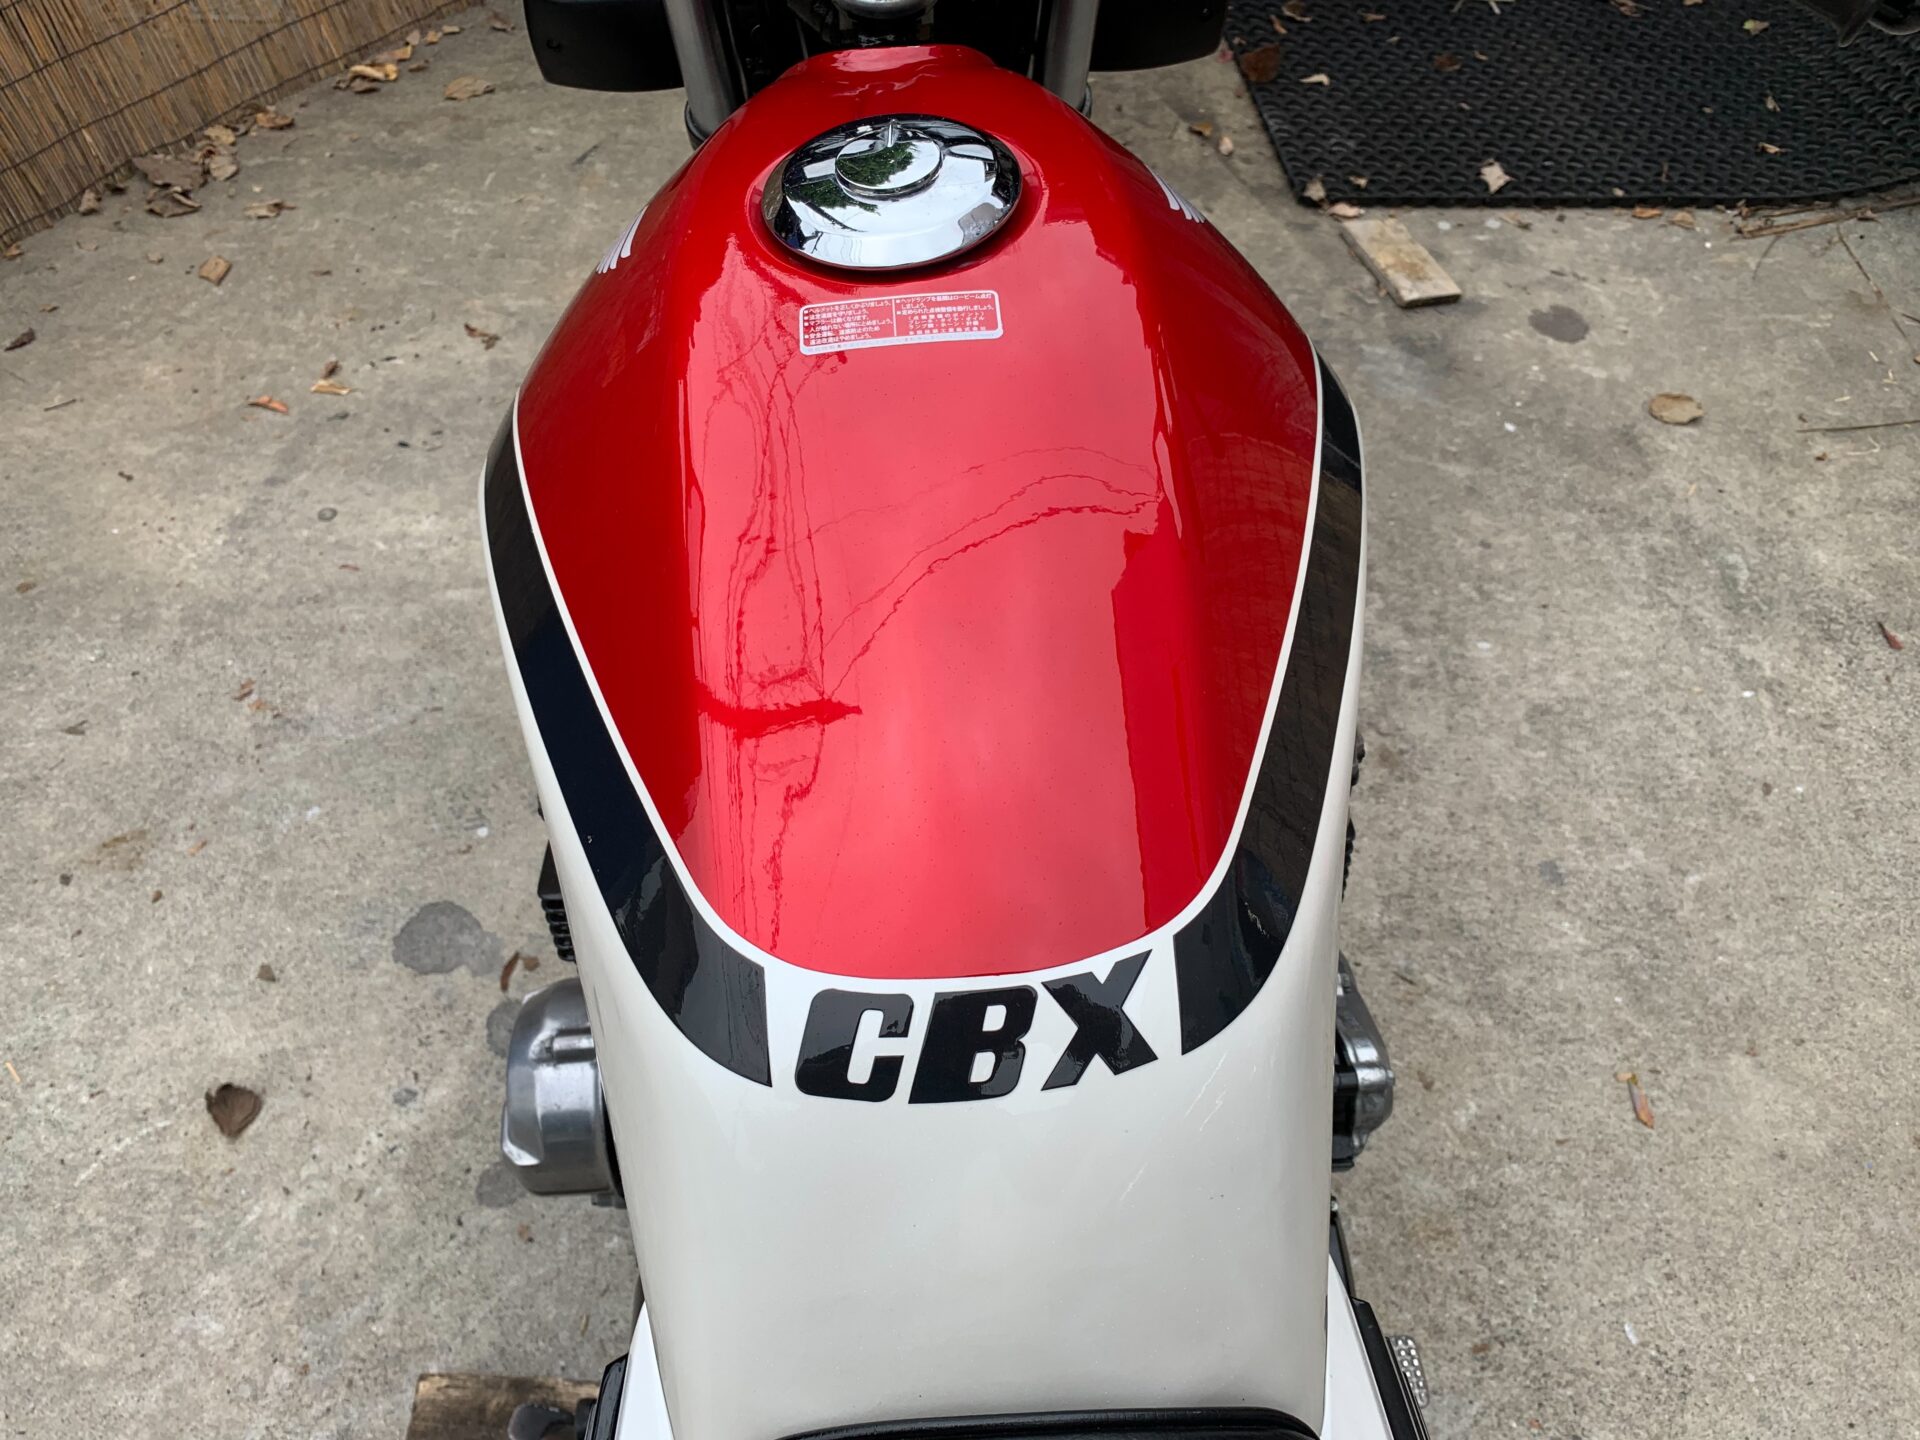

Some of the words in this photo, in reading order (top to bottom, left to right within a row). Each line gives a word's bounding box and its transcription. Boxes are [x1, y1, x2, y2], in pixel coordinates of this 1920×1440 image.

[901, 293, 992, 303] ヘッドランプをはロービーム点灯
[809, 315, 869, 326] マフラーはくなります。
[809, 318, 893, 333] 人がれない所にとめましょう。
[810, 333, 872, 346] はやめましょう。
[794, 949, 1158, 1104] CBX
